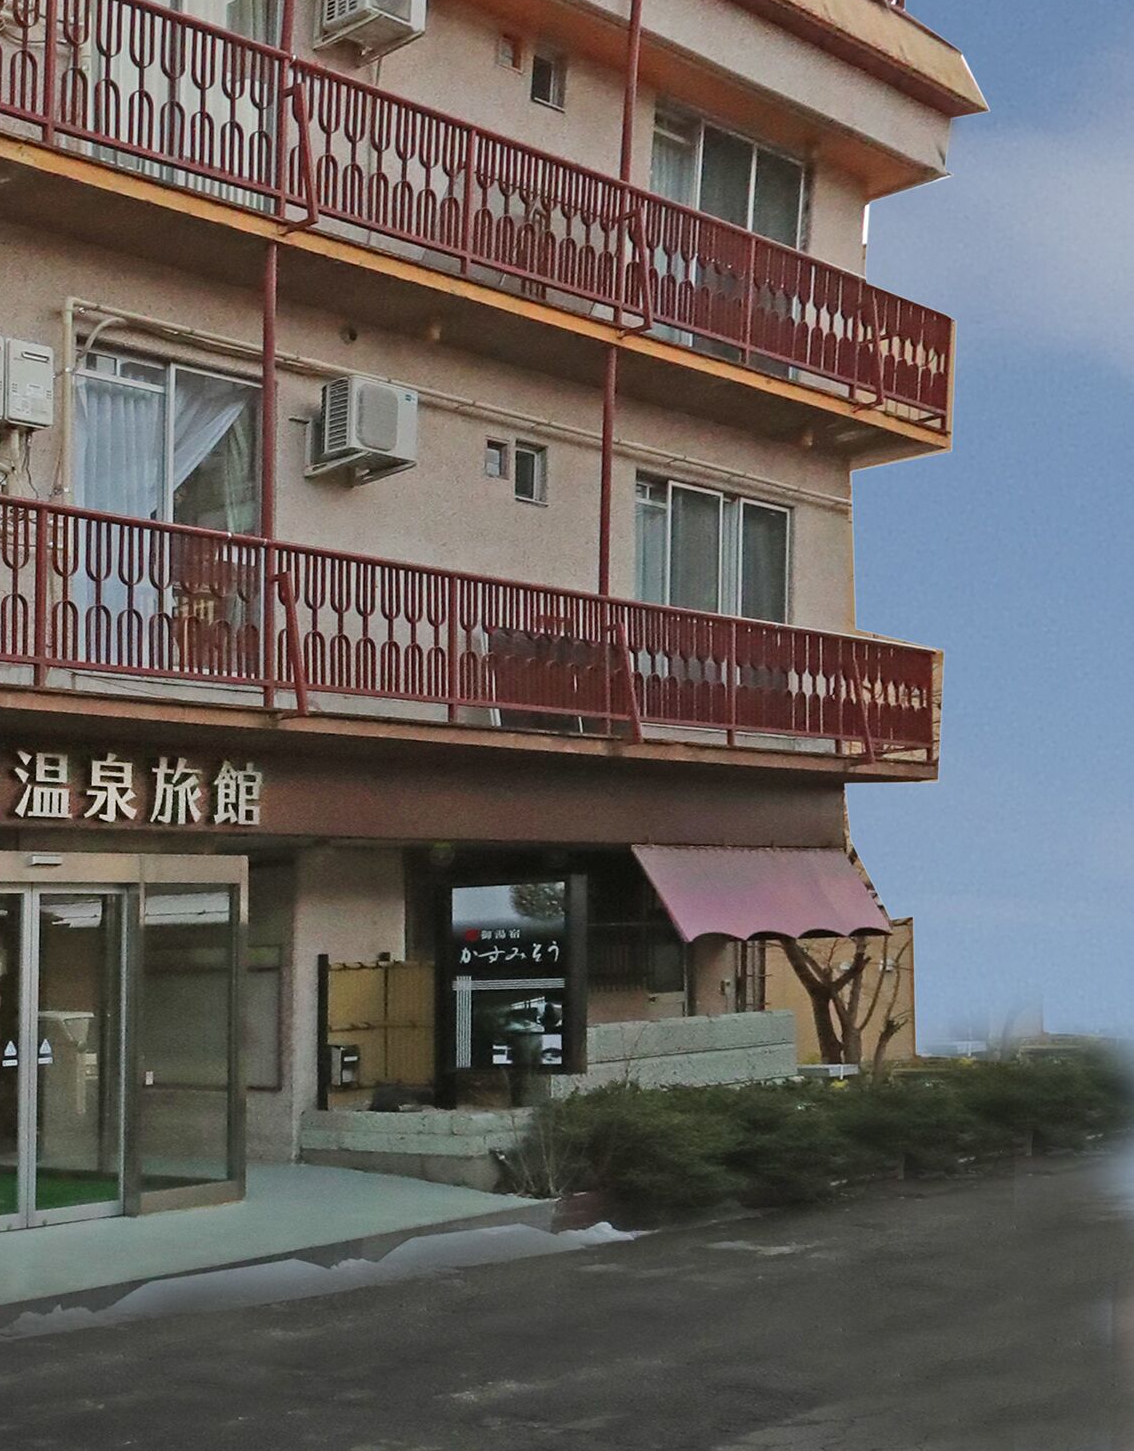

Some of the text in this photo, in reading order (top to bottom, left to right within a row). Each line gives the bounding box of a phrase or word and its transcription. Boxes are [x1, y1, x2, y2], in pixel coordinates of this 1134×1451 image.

[459, 940, 559, 964] かすみそう
